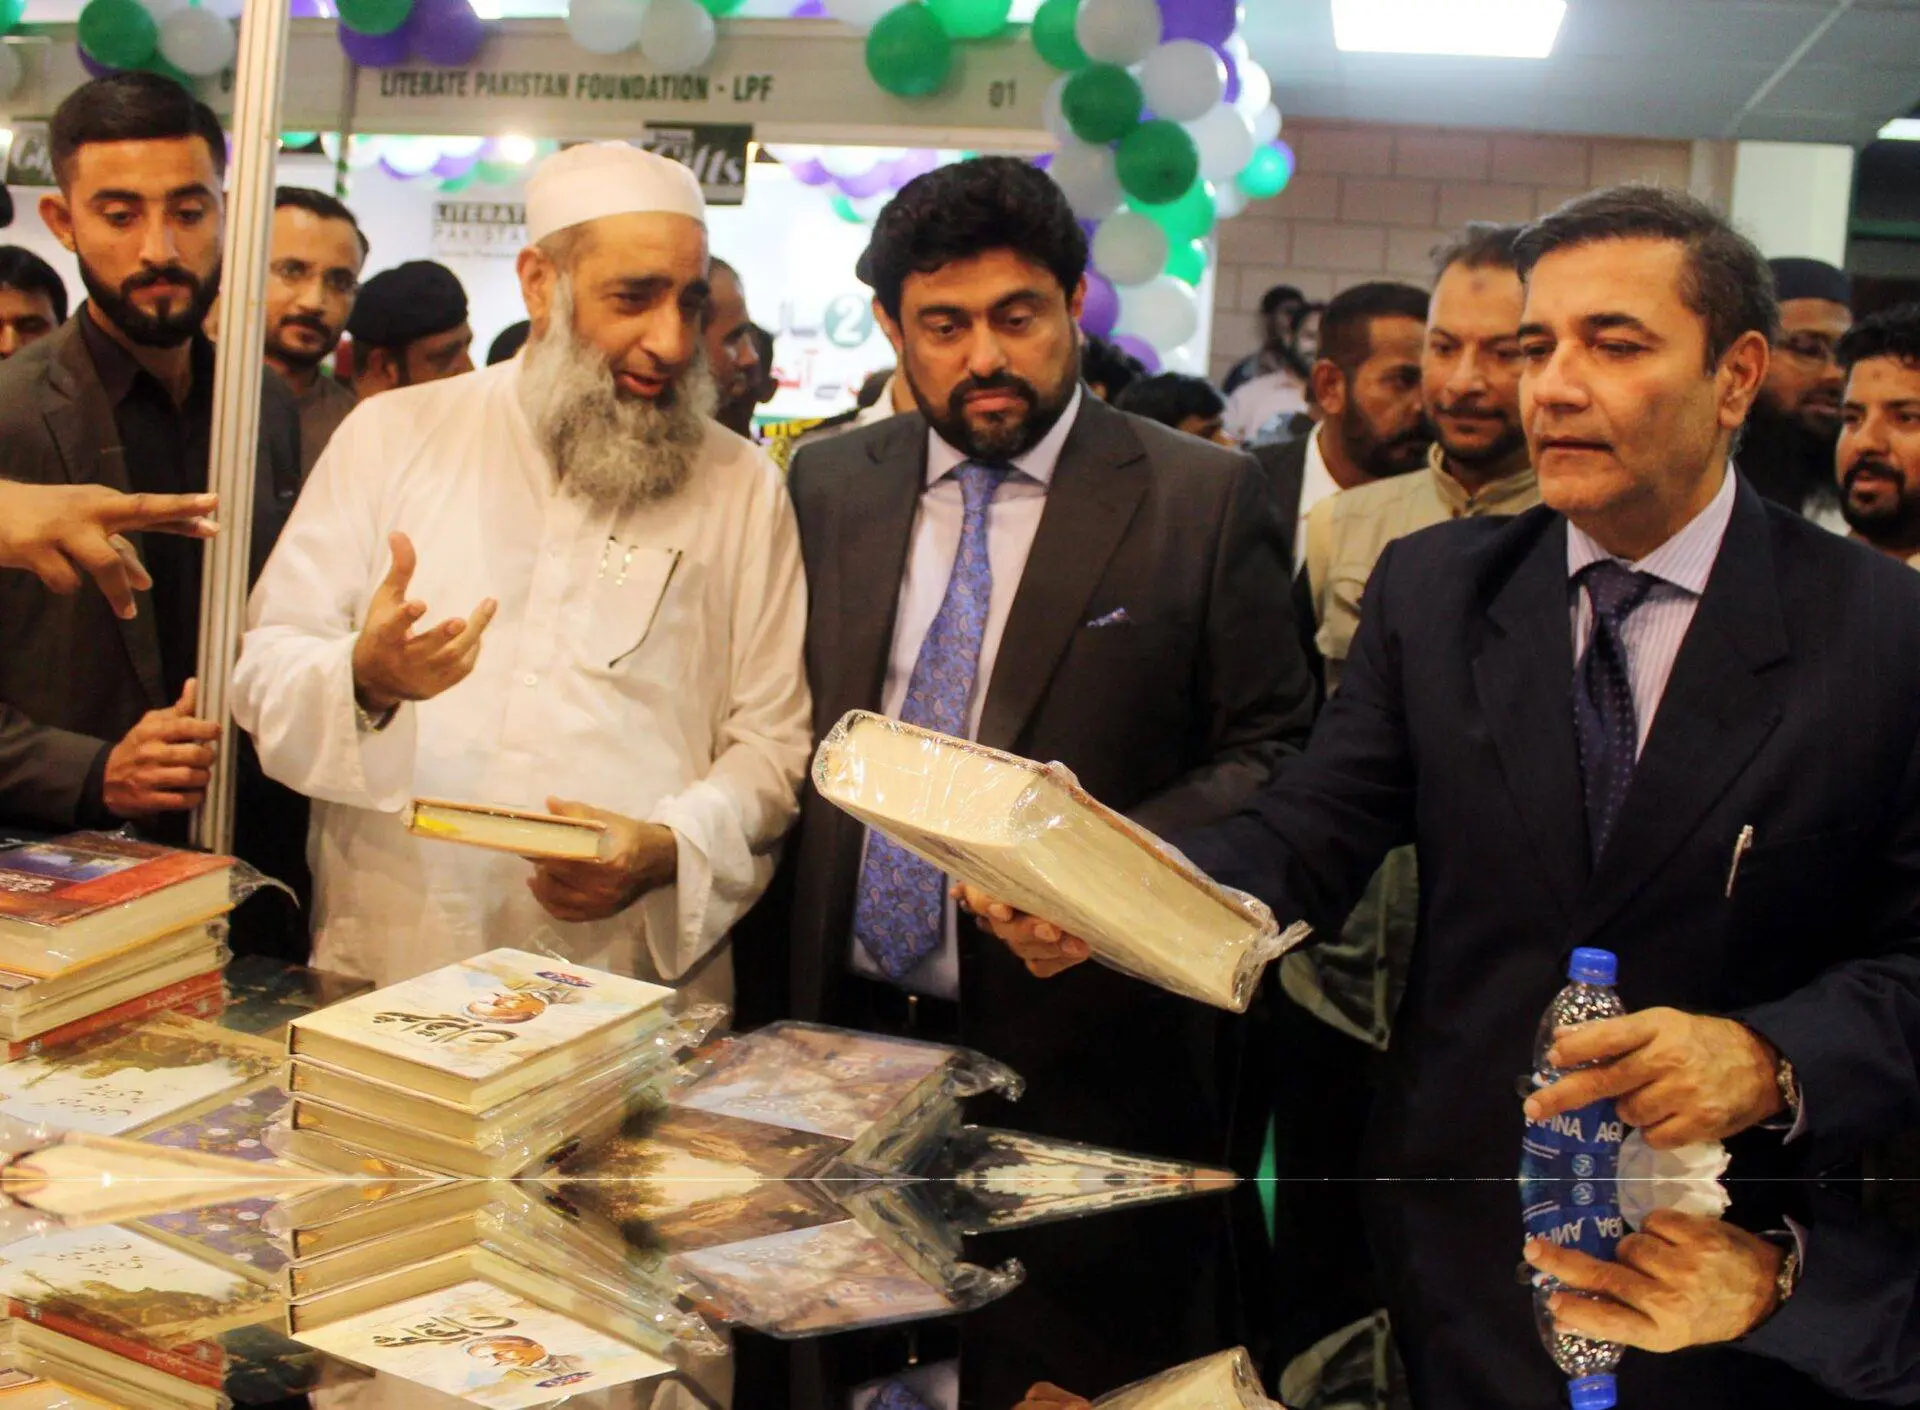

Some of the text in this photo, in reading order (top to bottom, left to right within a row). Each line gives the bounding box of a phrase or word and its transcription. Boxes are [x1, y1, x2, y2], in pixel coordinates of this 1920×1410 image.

[380, 70, 467, 97] LITERATE
[475, 71, 569, 99] PAKISTAN
[575, 73, 709, 102] FOUNDATION
[733, 74, 774, 102] LPF
[988, 79, 1016, 107] 01
[436, 203, 527, 224] LITERAT
[433, 226, 525, 243] PAKISTA
[832, 296, 864, 344] 2
